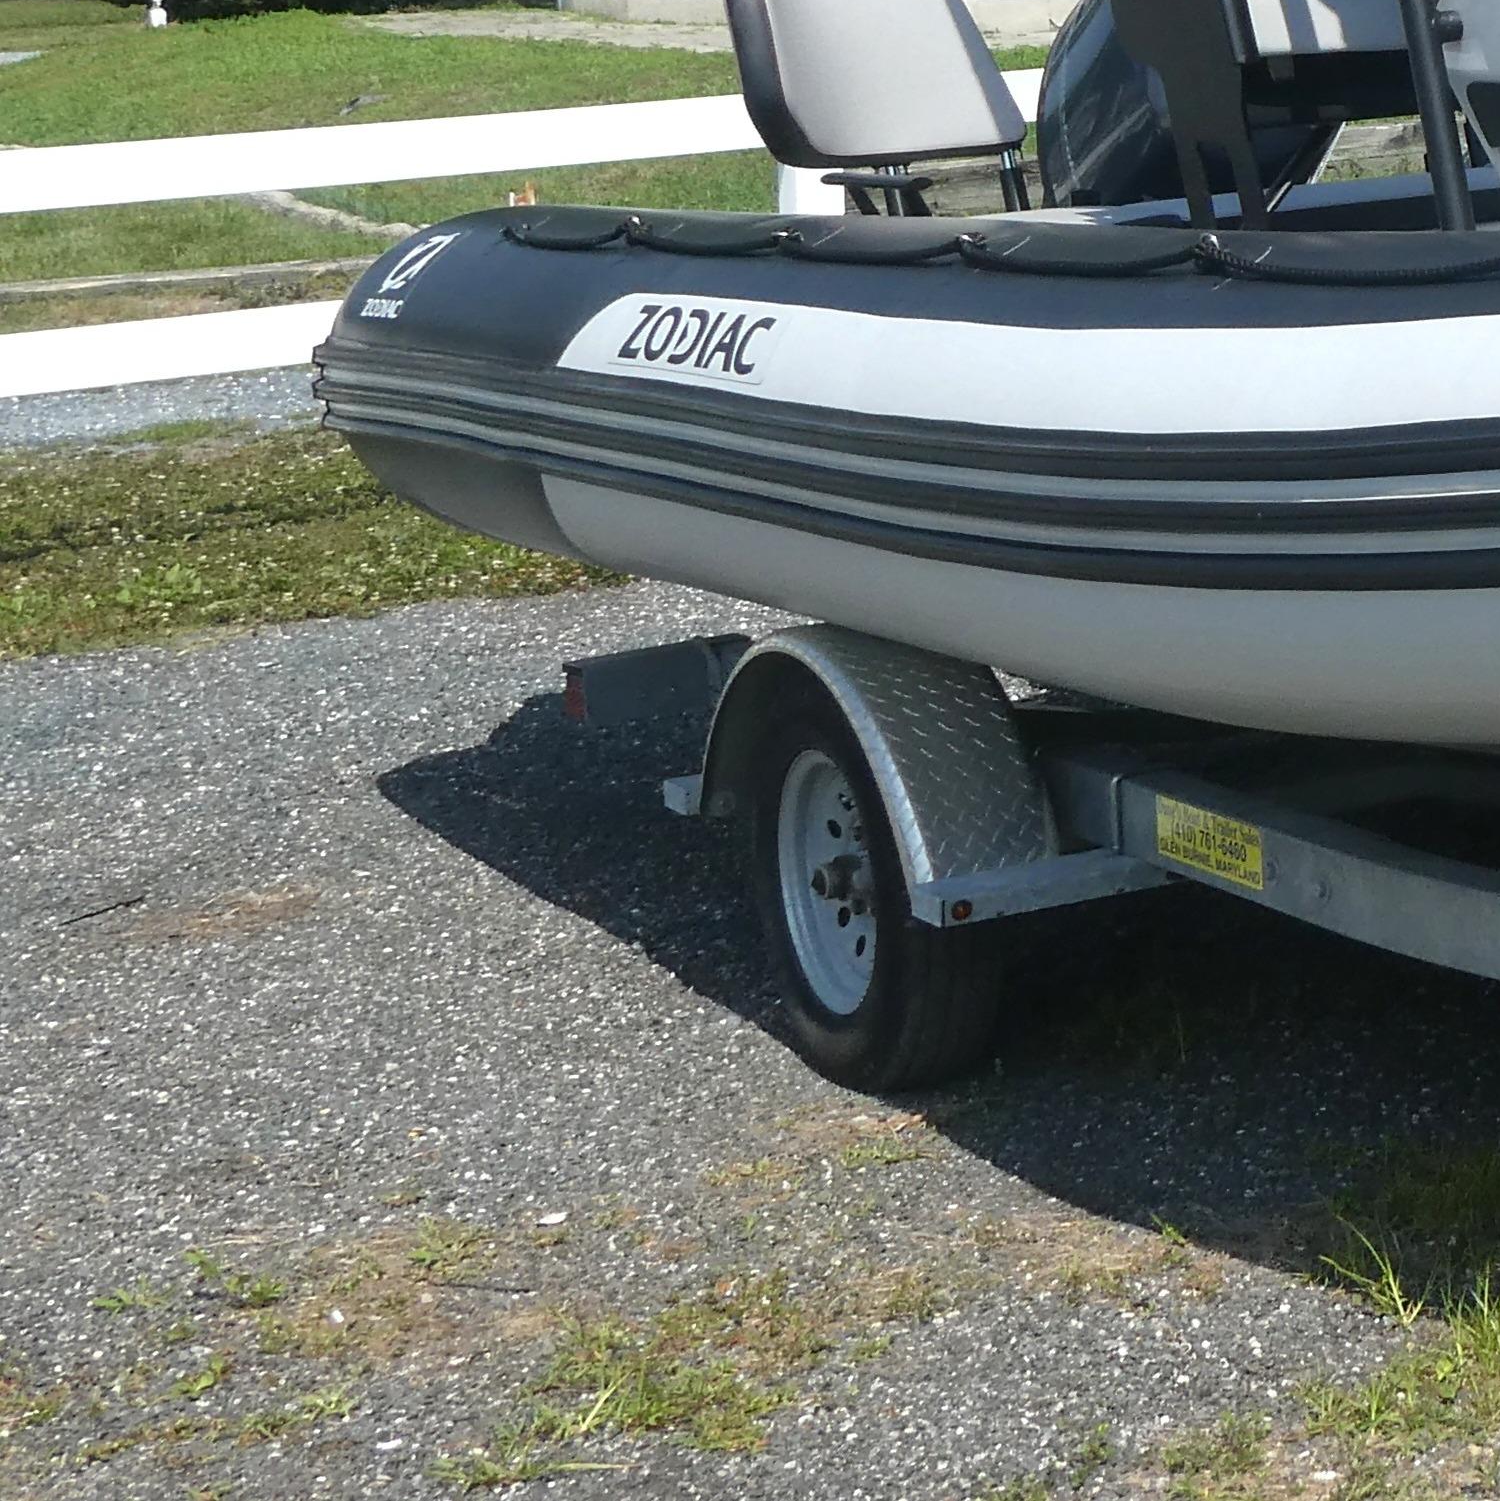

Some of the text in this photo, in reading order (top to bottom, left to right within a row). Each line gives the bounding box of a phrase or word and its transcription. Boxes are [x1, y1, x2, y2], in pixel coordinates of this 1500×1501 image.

[618, 304, 777, 375] ZODIAC
[1171, 821, 1196, 848] (410)
[1215, 858, 1260, 886] MARYLAND
